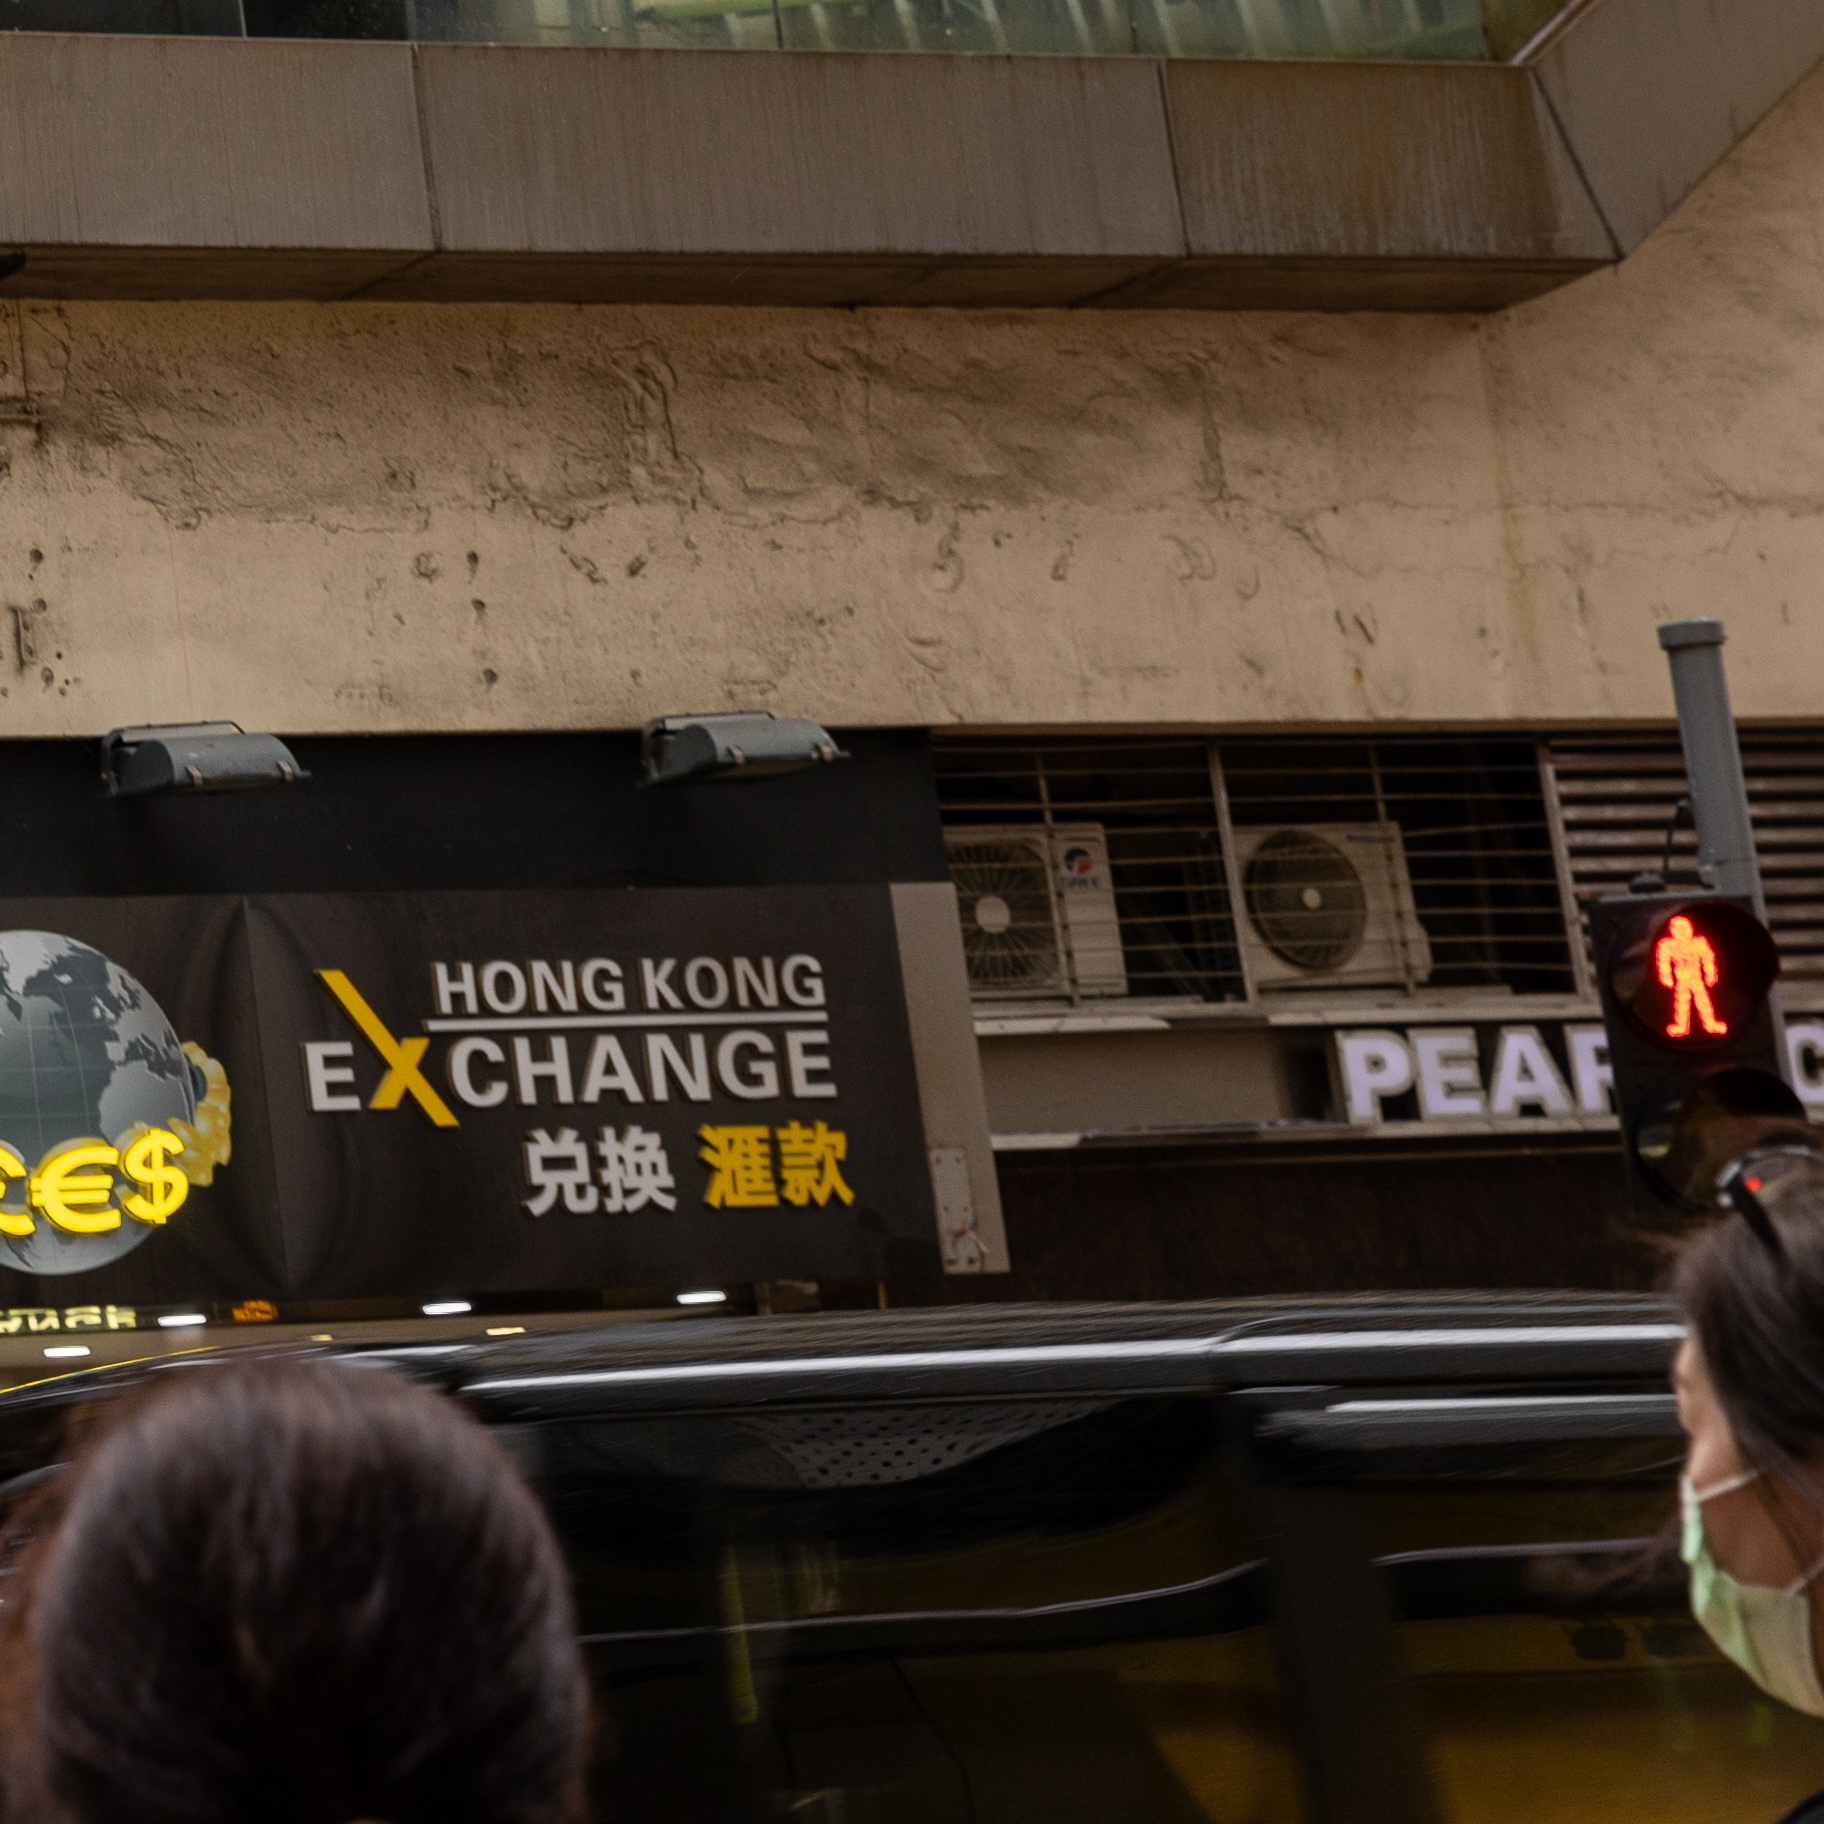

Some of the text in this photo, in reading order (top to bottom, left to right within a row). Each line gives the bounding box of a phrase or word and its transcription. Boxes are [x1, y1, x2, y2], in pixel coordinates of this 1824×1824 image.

[432, 954, 827, 1016] HONG KONG
[303, 969, 839, 1127] EXCHANGE
